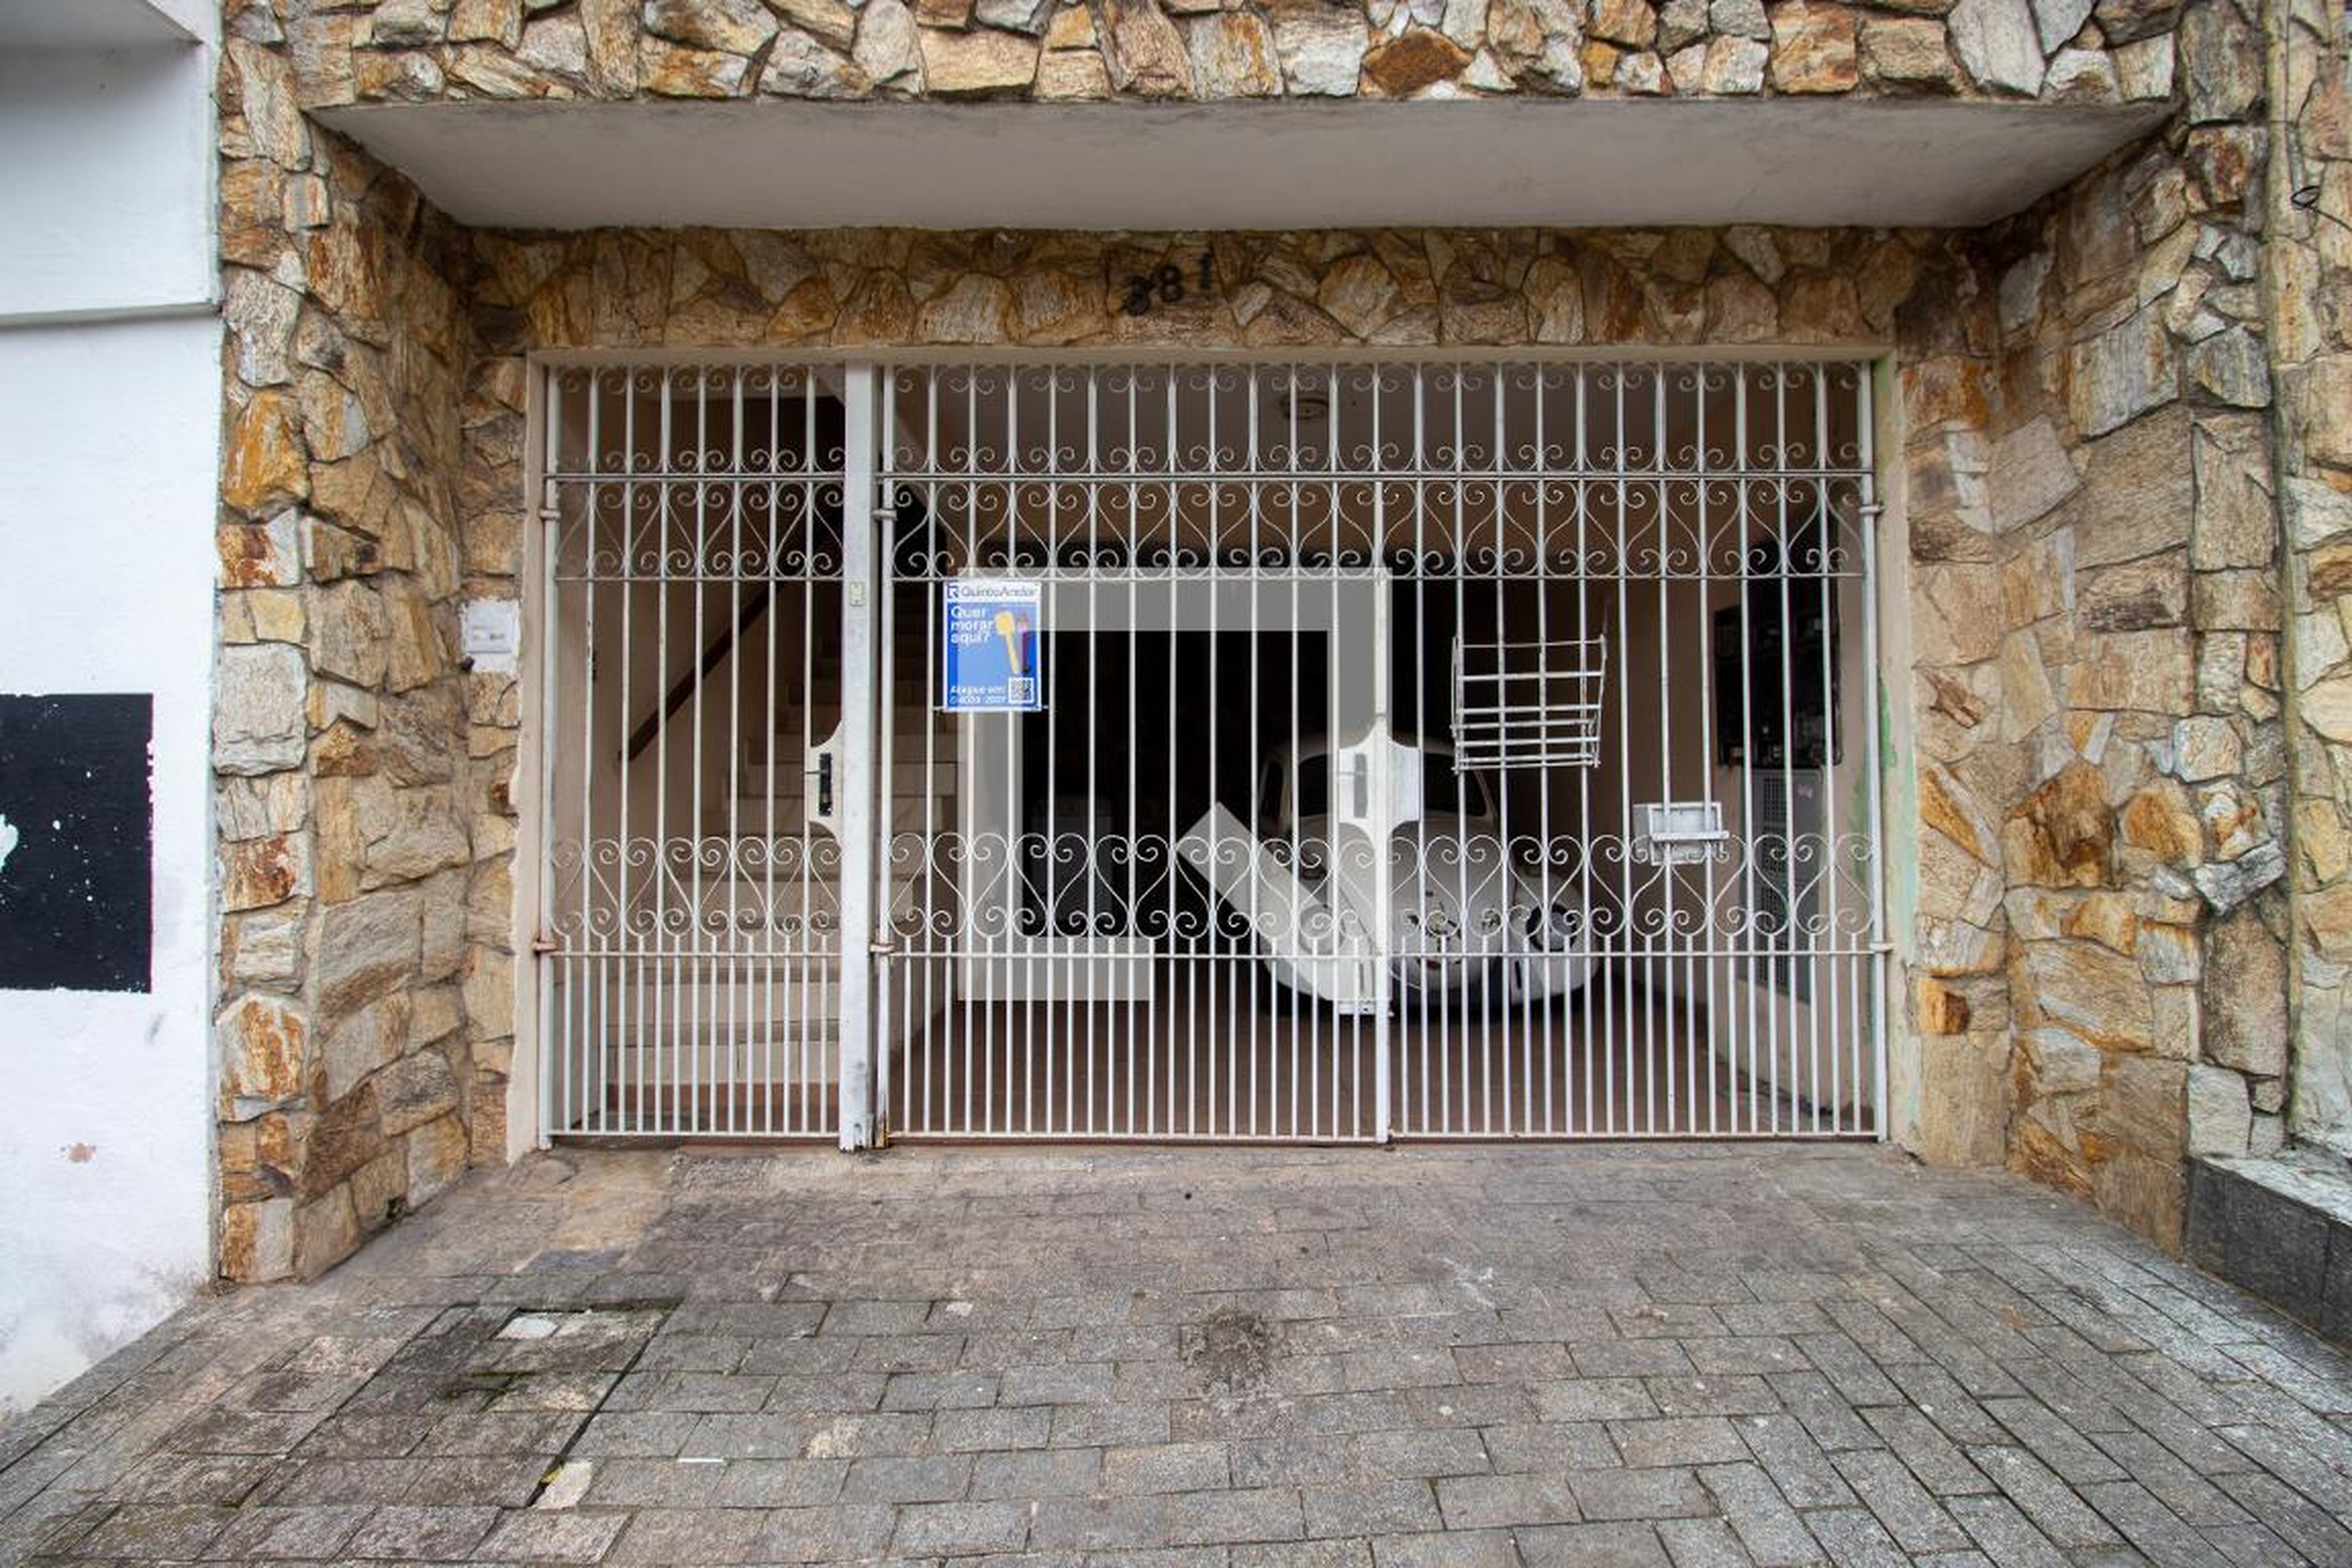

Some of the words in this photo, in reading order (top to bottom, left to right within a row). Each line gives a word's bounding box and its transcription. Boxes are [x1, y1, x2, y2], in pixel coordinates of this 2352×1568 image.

[951, 605, 986, 619] Quer
[951, 620, 994, 631] morar
[951, 631, 991, 646] aqui?
